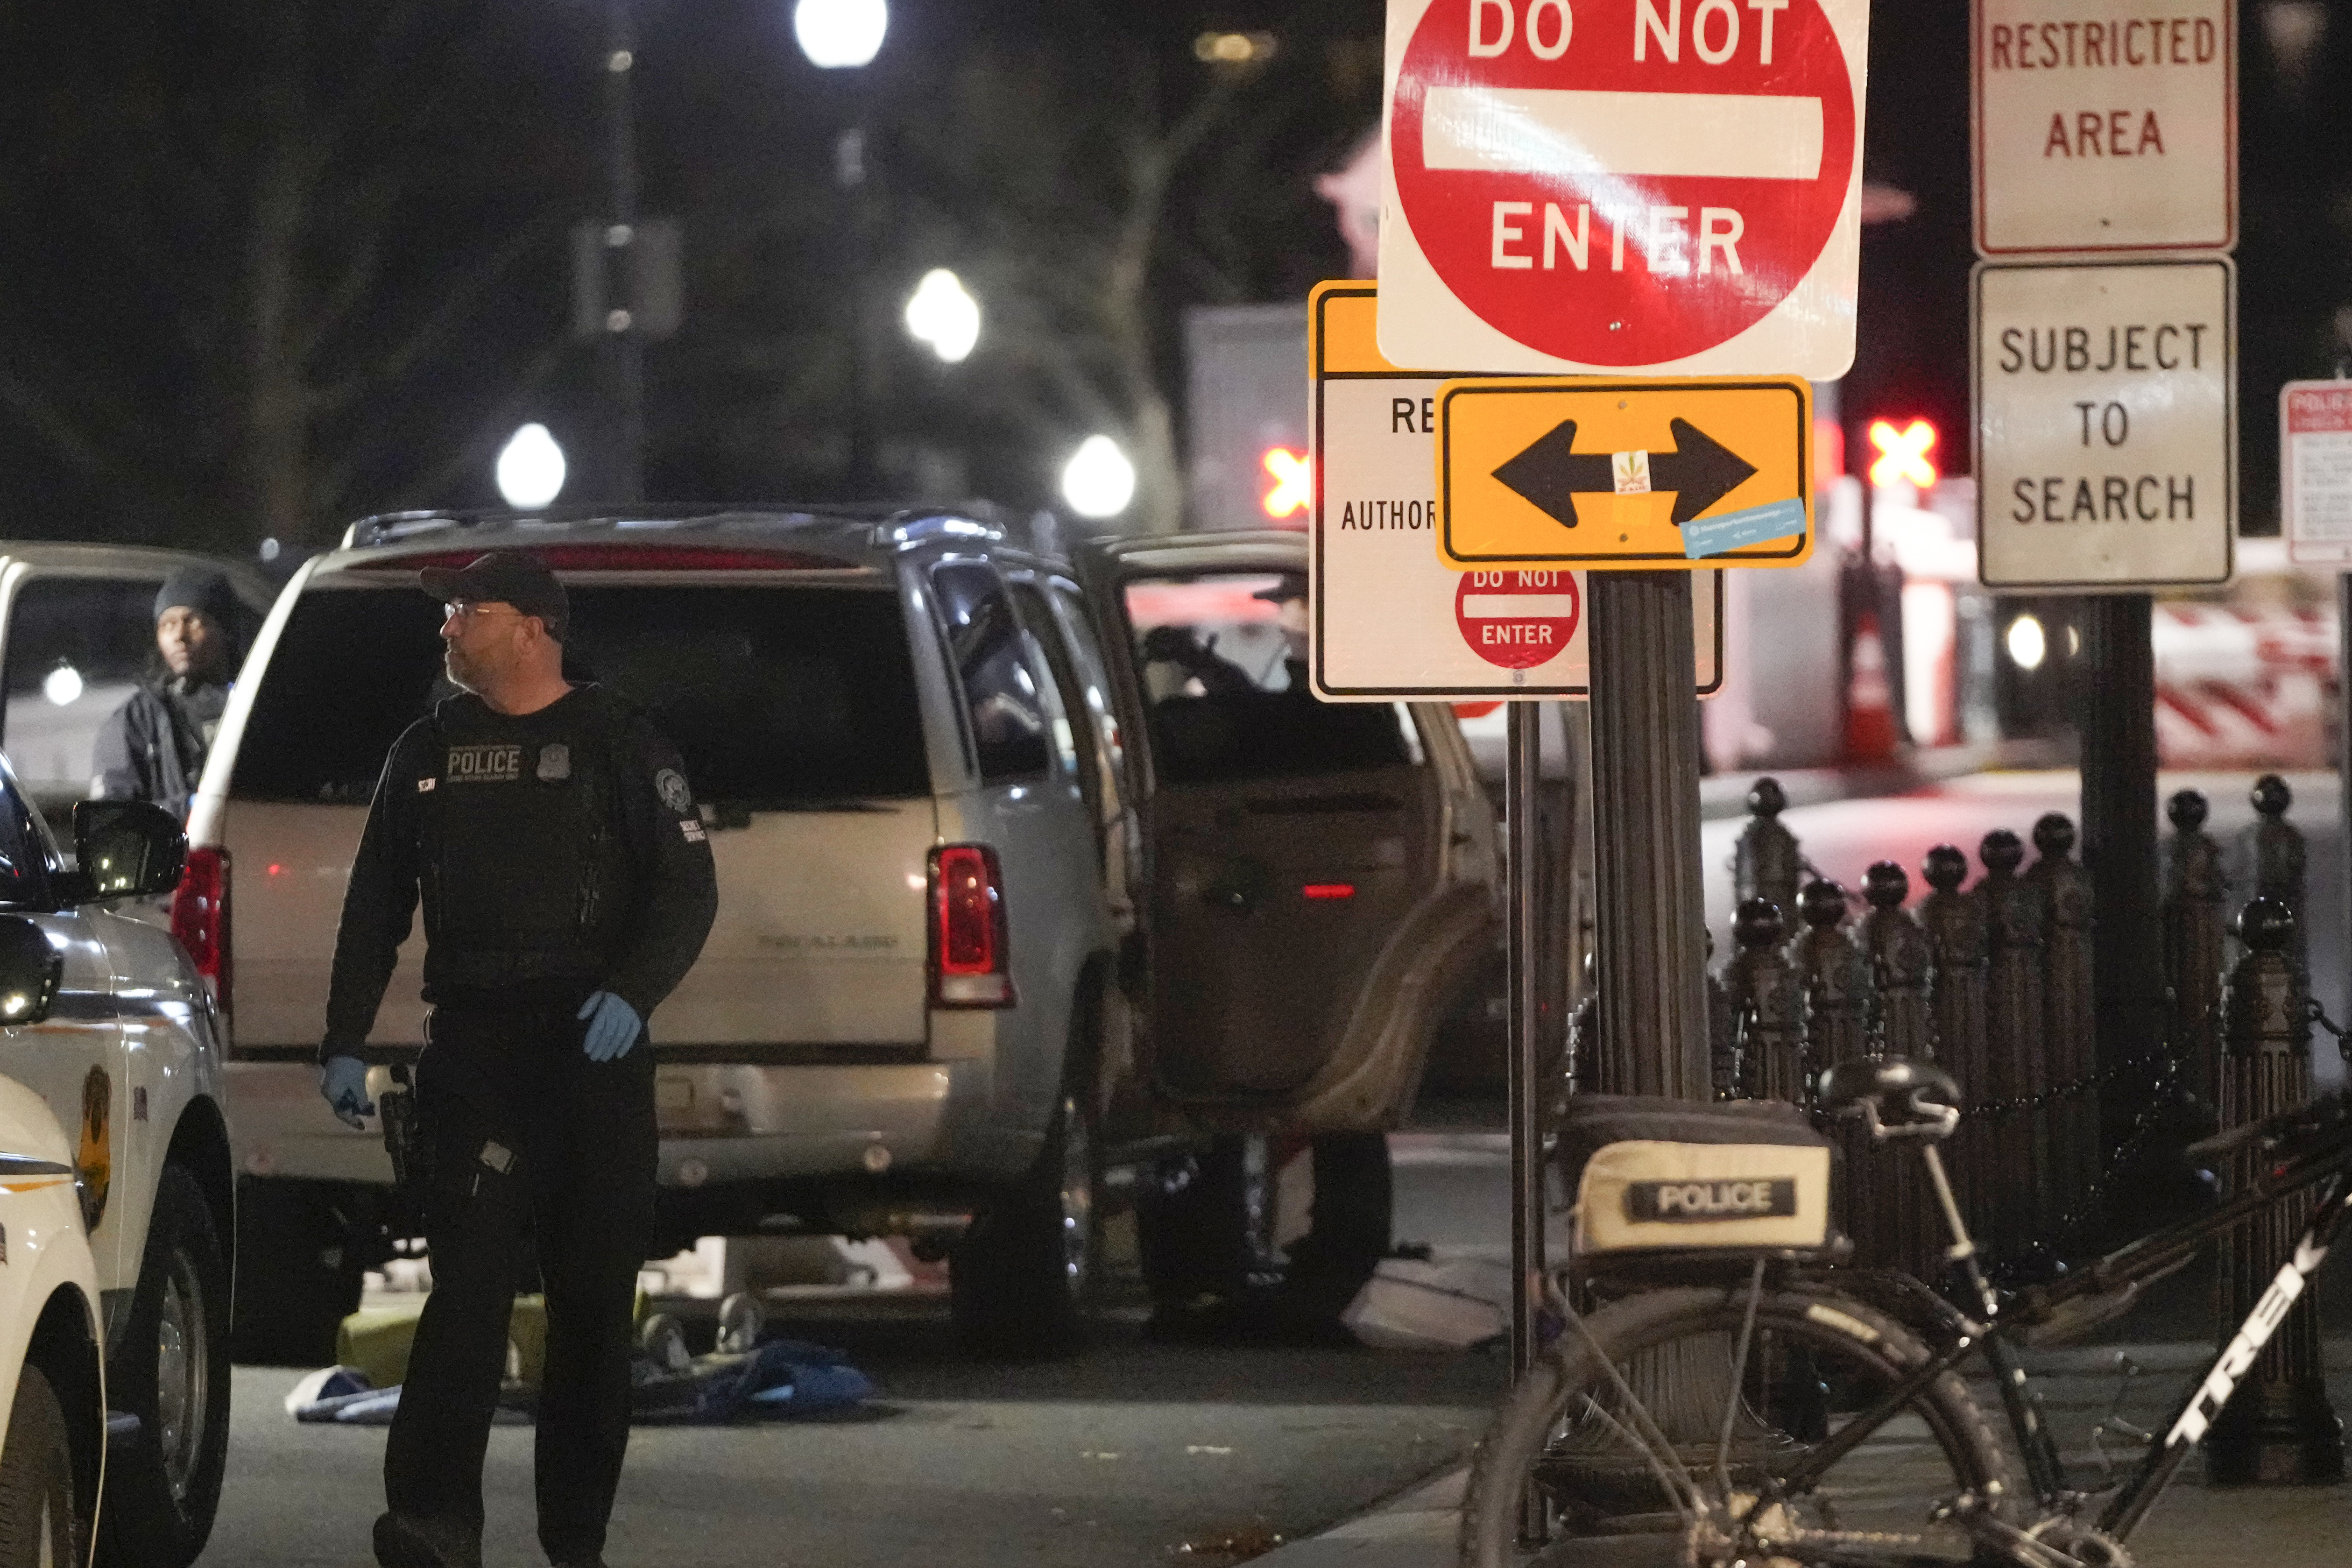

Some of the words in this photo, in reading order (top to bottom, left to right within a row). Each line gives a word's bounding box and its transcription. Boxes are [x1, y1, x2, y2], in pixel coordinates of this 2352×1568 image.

[1468, 0, 1574, 61] DO
[1633, 0, 1790, 65] NOT
[1991, 17, 2217, 69] RESTRICTED
[2044, 108, 2166, 158] AREA
[1491, 201, 1745, 275] ENTER
[1999, 323, 2207, 373] SUBJECT
[2075, 401, 2129, 447] TO
[2012, 474, 2195, 523] SEARCH
[1473, 570, 1504, 587] DO
[1518, 569, 1558, 587] NOT
[1482, 625, 1553, 645] ENTER
[447, 749, 521, 774] POLICE
[1658, 1182, 1773, 1215] POLICE
[2164, 1229, 2330, 1447] TREK
